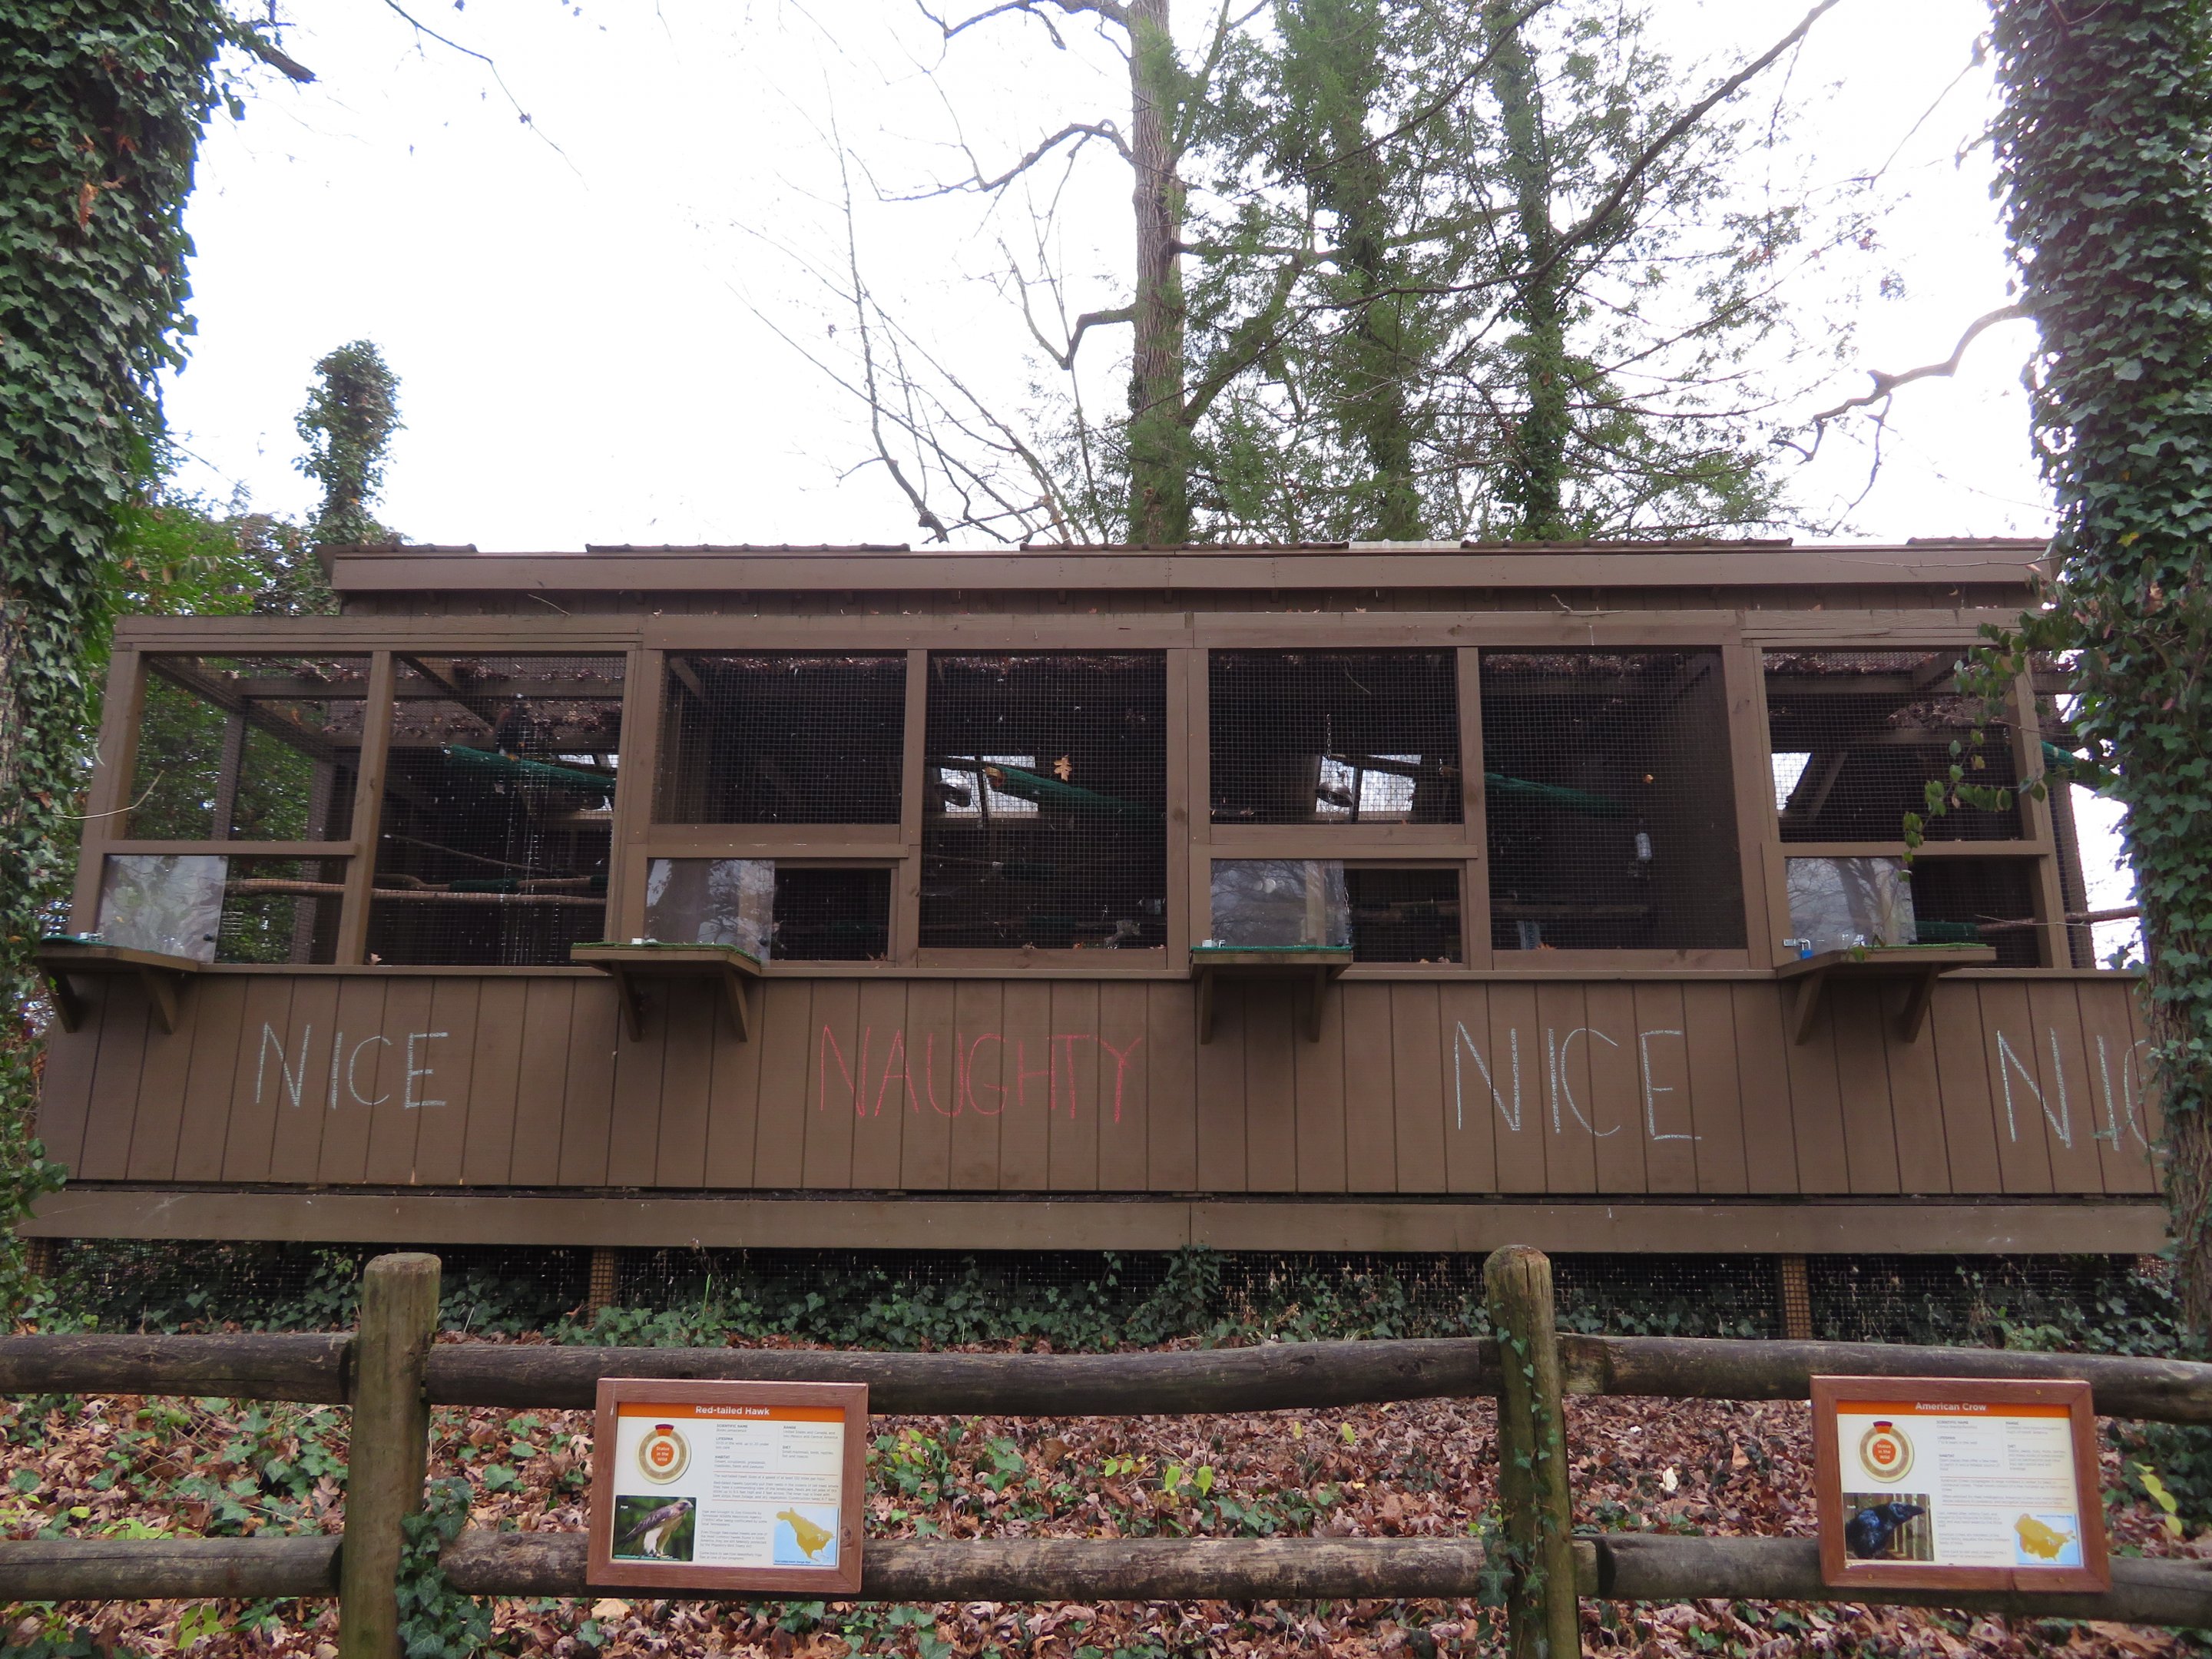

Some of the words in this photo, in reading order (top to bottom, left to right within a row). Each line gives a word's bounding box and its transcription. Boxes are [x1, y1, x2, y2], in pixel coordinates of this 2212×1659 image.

[256, 1022, 449, 1110] NICE
[820, 1024, 1142, 1124] NAUGHTY
[1454, 1020, 1703, 1141] NICE
[695, 1406, 743, 1415] Red-tailed
[745, 1407, 770, 1416] Hawk
[1916, 1402, 1959, 1410] American
